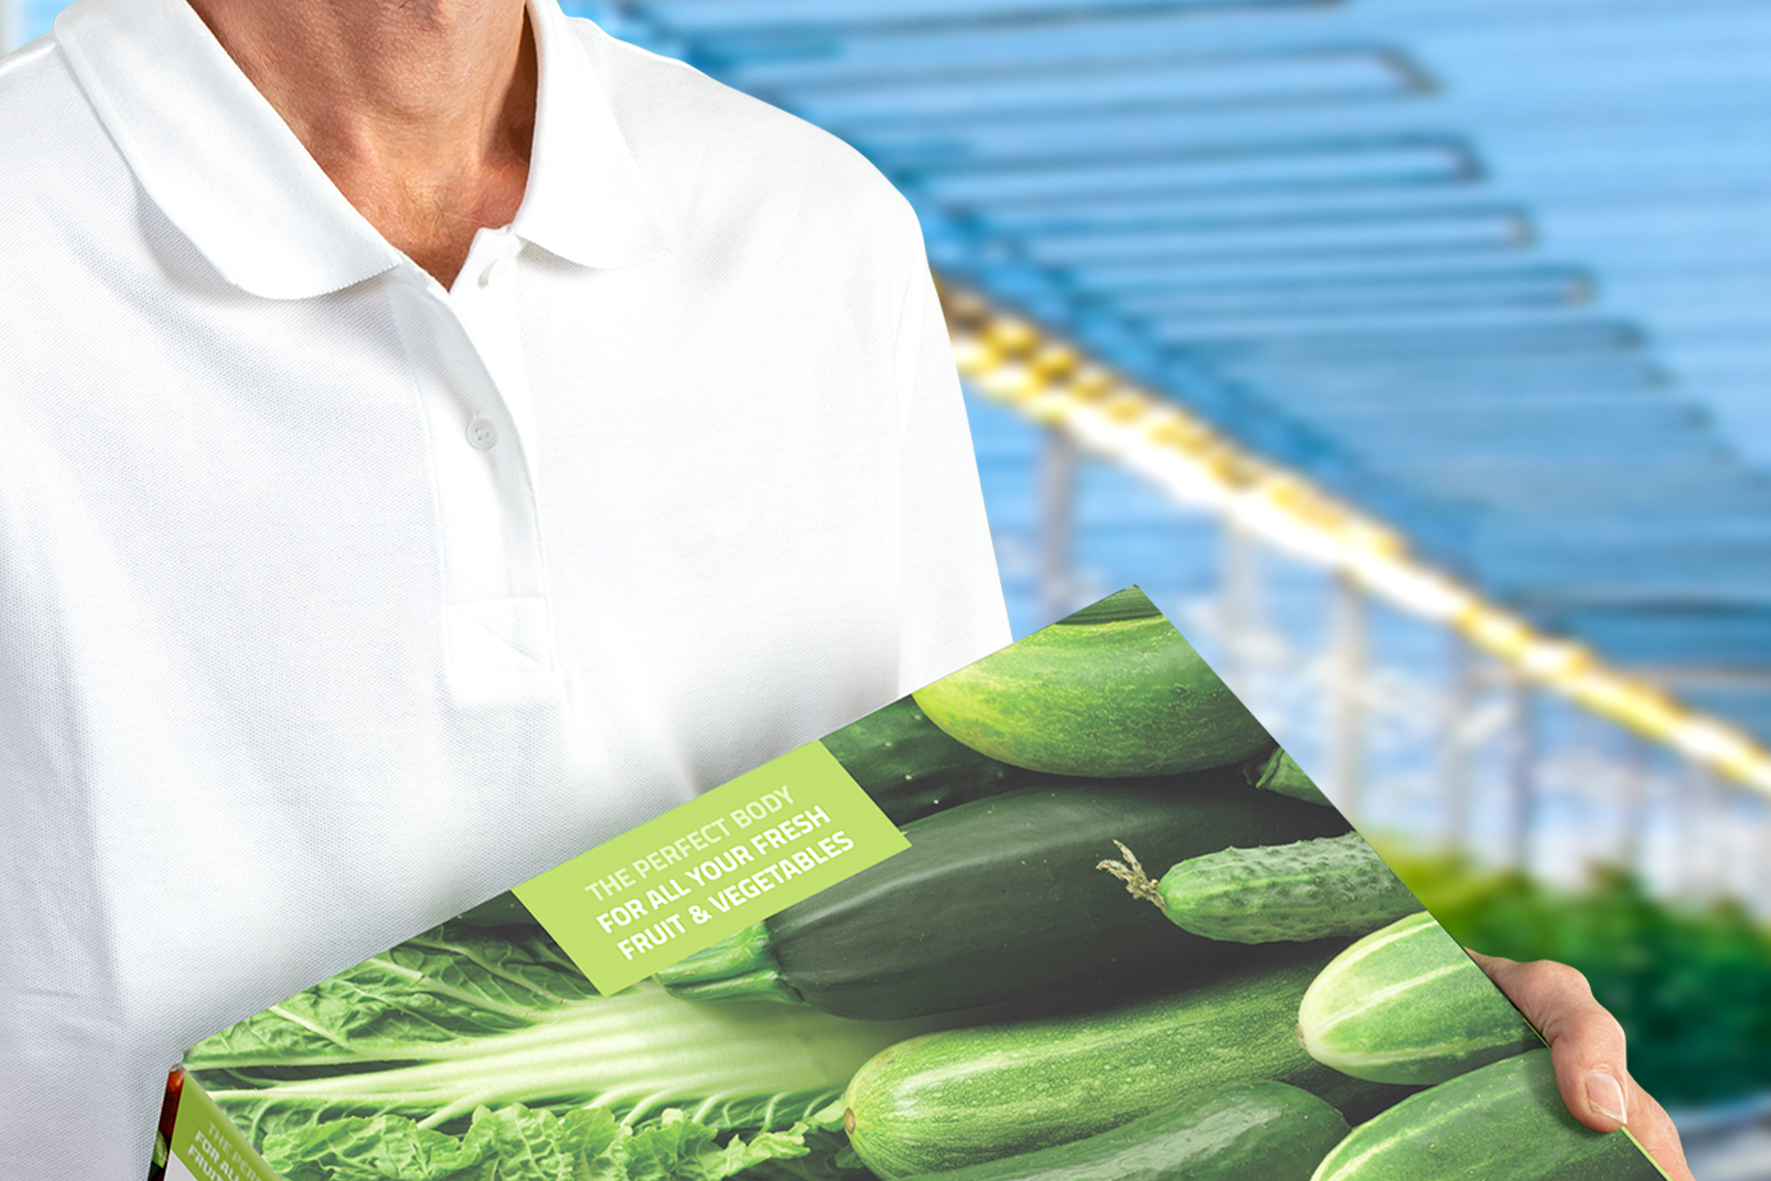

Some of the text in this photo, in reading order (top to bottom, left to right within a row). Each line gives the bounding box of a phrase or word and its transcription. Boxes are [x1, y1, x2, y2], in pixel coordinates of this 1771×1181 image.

[585, 785, 795, 901] THE PERFECT BODY
[596, 805, 832, 934] FOR ALL YOUR FRESH
[616, 830, 855, 961] FRUIT & VEGETABLES
[195, 1131, 220, 1162] FOR
[208, 1122, 232, 1151] THE
